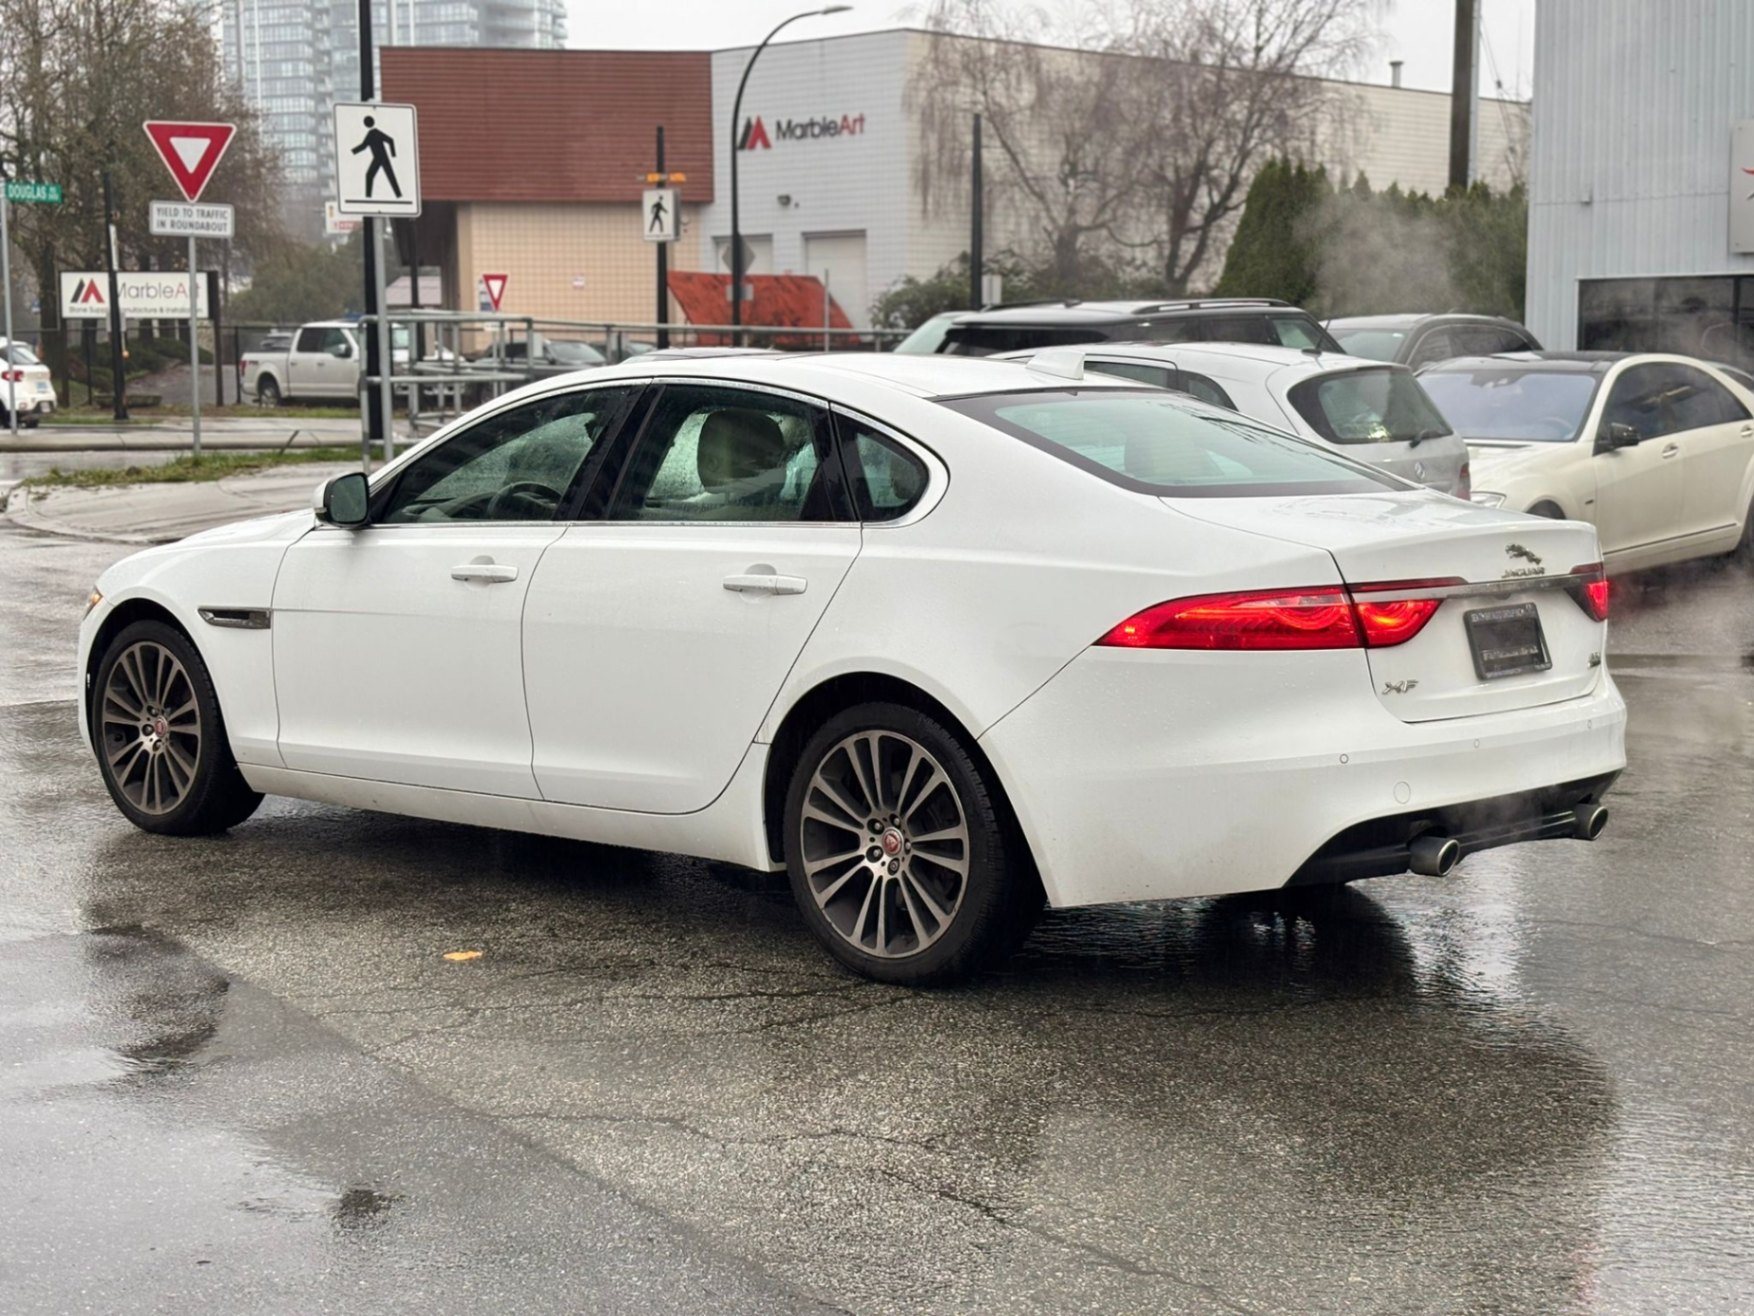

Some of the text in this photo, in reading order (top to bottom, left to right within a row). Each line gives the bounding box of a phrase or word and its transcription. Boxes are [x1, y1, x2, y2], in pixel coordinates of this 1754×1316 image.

[775, 112, 866, 140] MarbleArt
[8, 183, 46, 199] DOUGLAS
[156, 207, 228, 219] YIELD TO TRAFFIC
[156, 219, 228, 232] IN ROUNDABOUT
[1501, 567, 1545, 579] JAGUAR
[1382, 680, 1419, 695] XF
